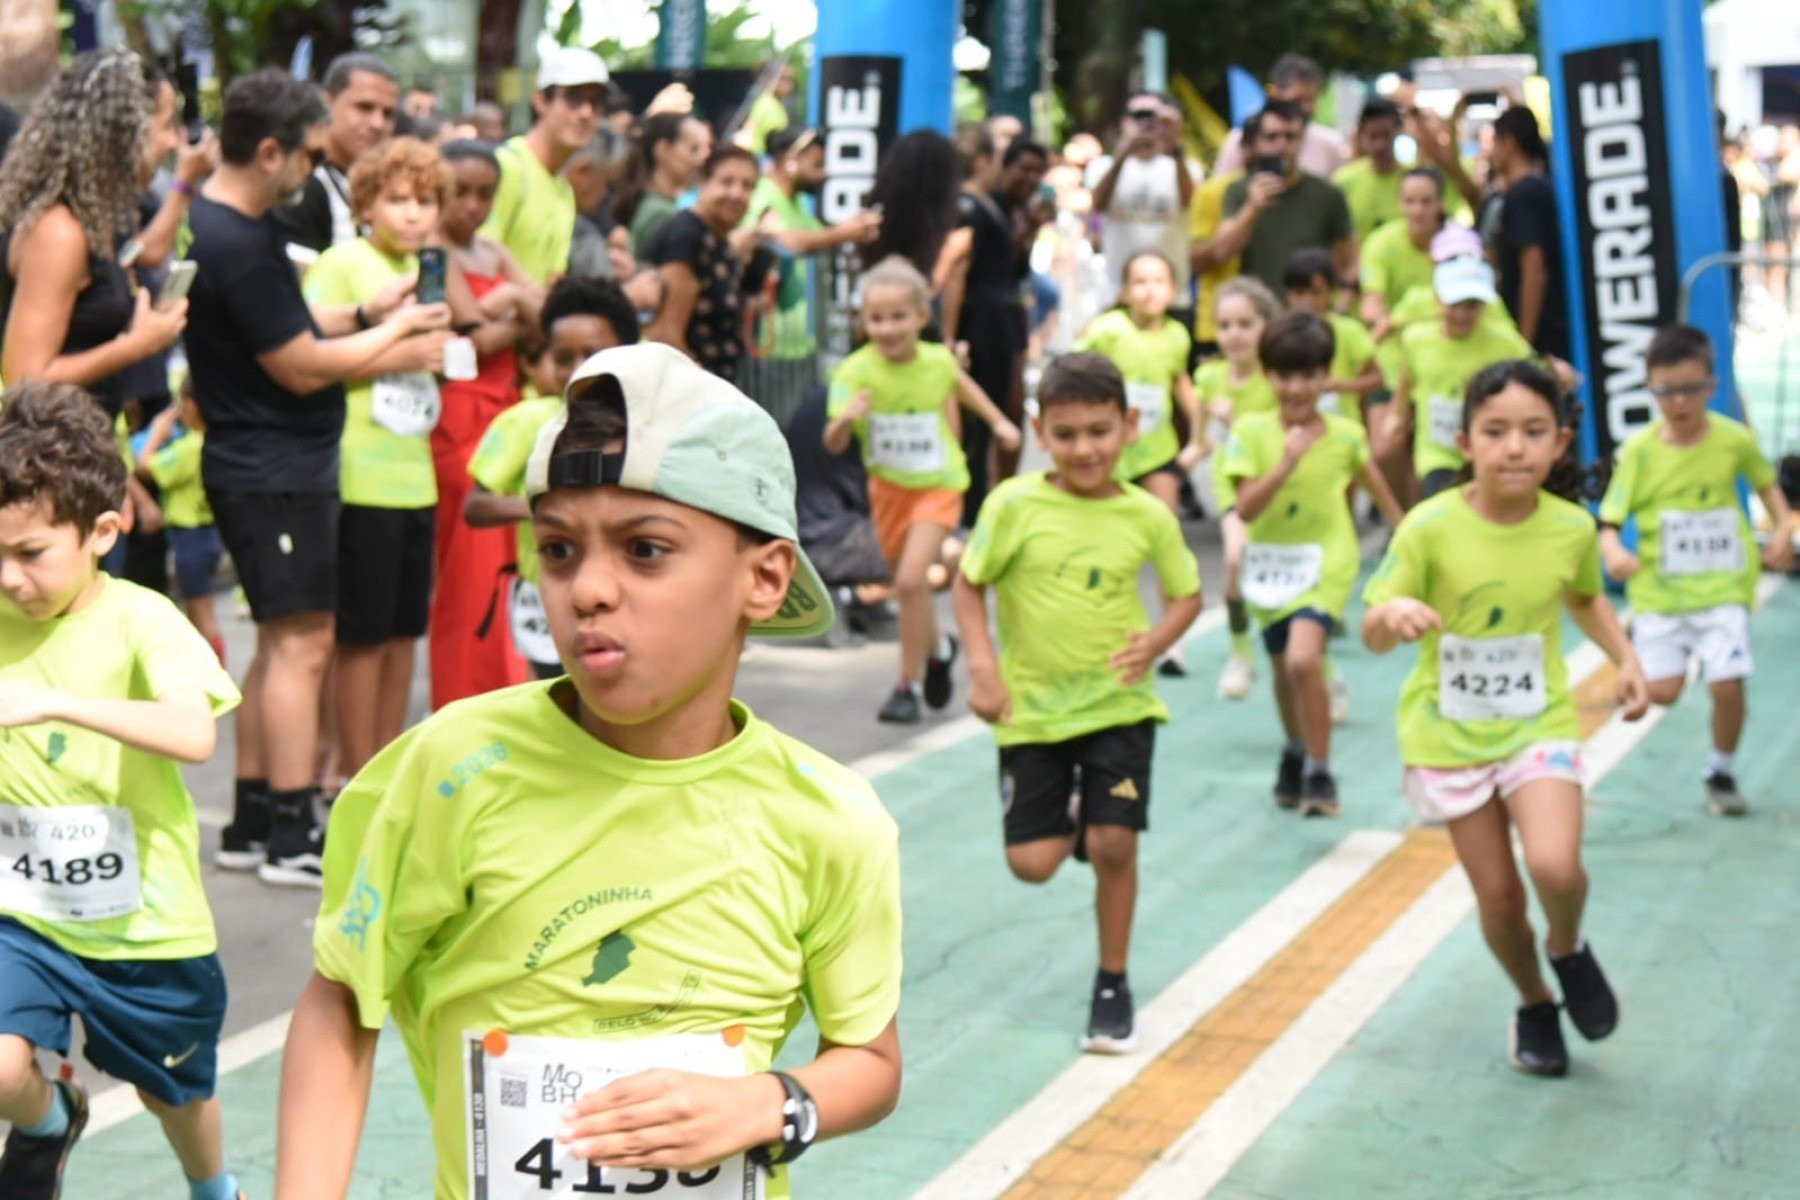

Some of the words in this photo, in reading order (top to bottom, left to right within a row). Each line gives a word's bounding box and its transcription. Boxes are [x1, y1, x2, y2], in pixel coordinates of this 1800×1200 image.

[1579, 77, 1661, 462] OWERADE
[1450, 672, 1532, 696] 4224
[12, 852, 124, 885] 4189
[523, 887, 653, 971] MARATONINHA
